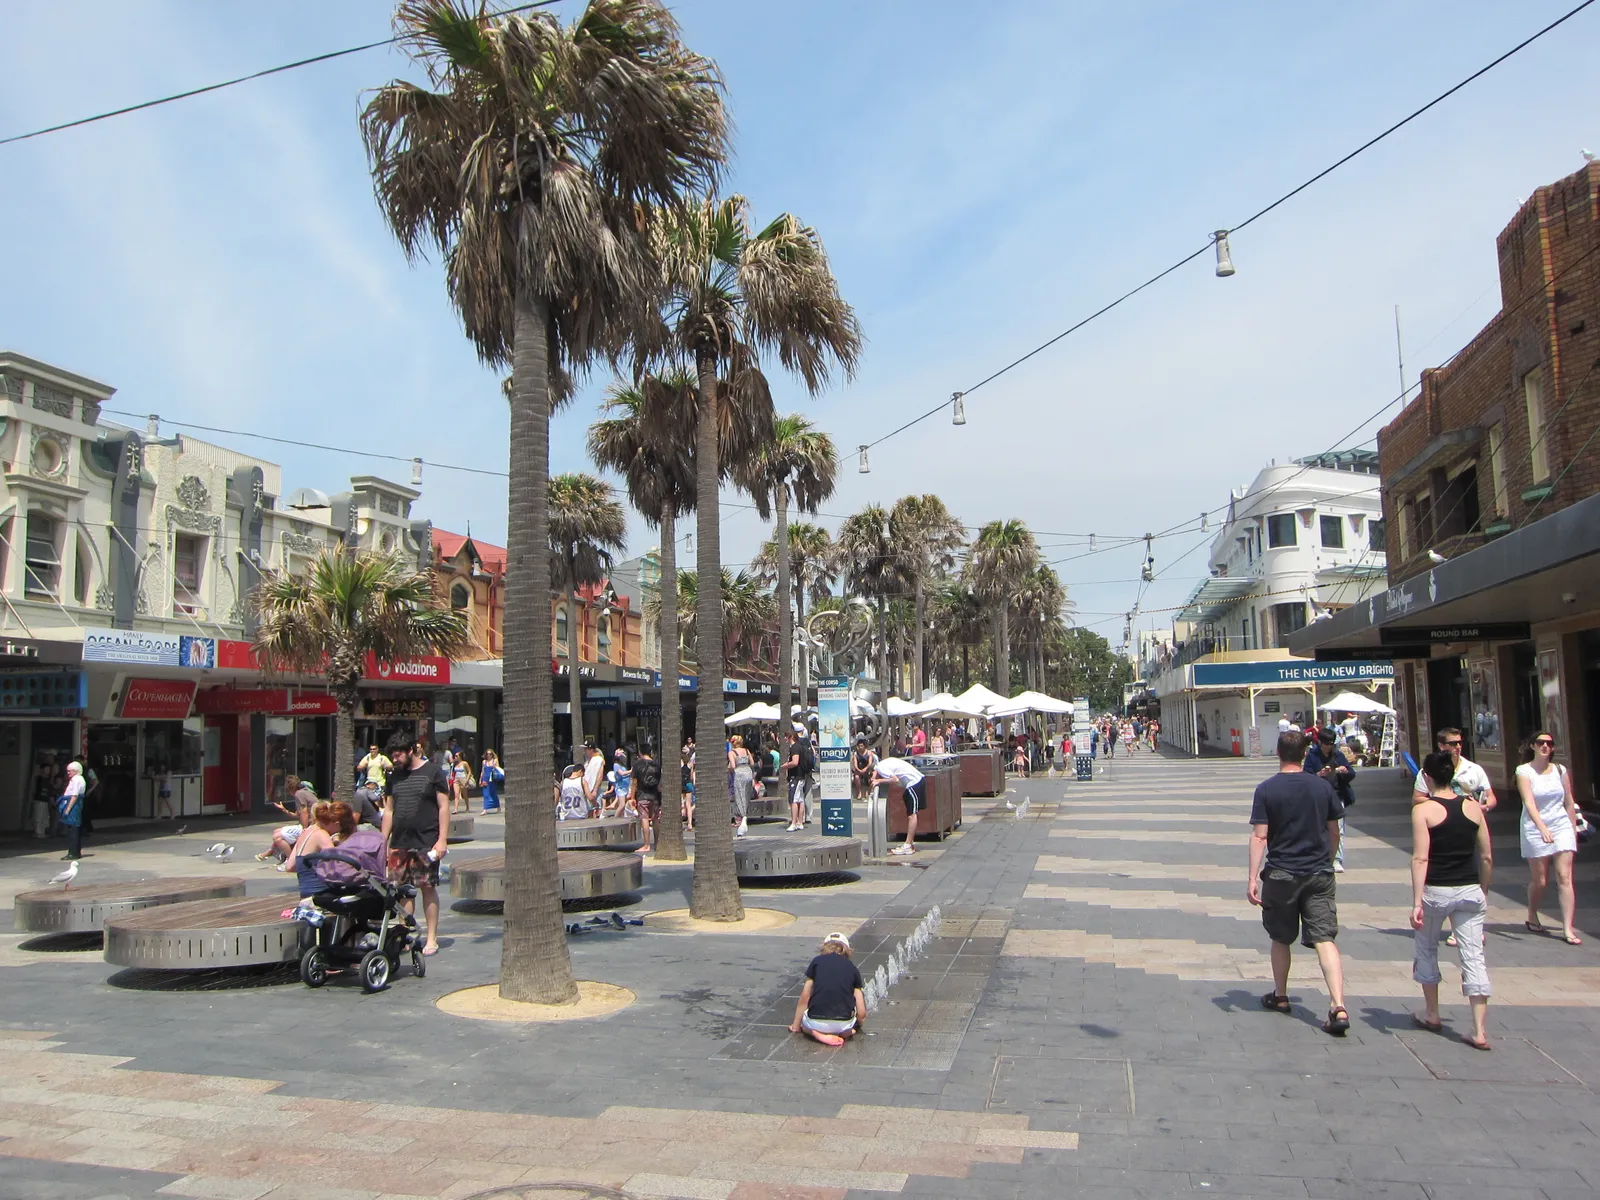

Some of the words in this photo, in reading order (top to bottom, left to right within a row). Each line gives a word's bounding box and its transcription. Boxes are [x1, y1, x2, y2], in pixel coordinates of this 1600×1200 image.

[123, 631, 144, 639] MANLY
[1430, 630, 1460, 638] ROUND
[87, 635, 132, 647] OCEAN
[138, 640, 178, 651] FOODS
[394, 662, 438, 676] vodafone
[1278, 669, 1300, 679] THE
[1303, 668, 1328, 678] NEW
[1331, 666, 1356, 676] NEW
[1359, 665, 1394, 675] BRIGHTO
[129, 688, 192, 703] COPENHAGEN
[291, 701, 321, 710] odafone
[374, 700, 426, 713] KEBABS
[821, 750, 848, 759] manly
[564, 795, 582, 809] 20
